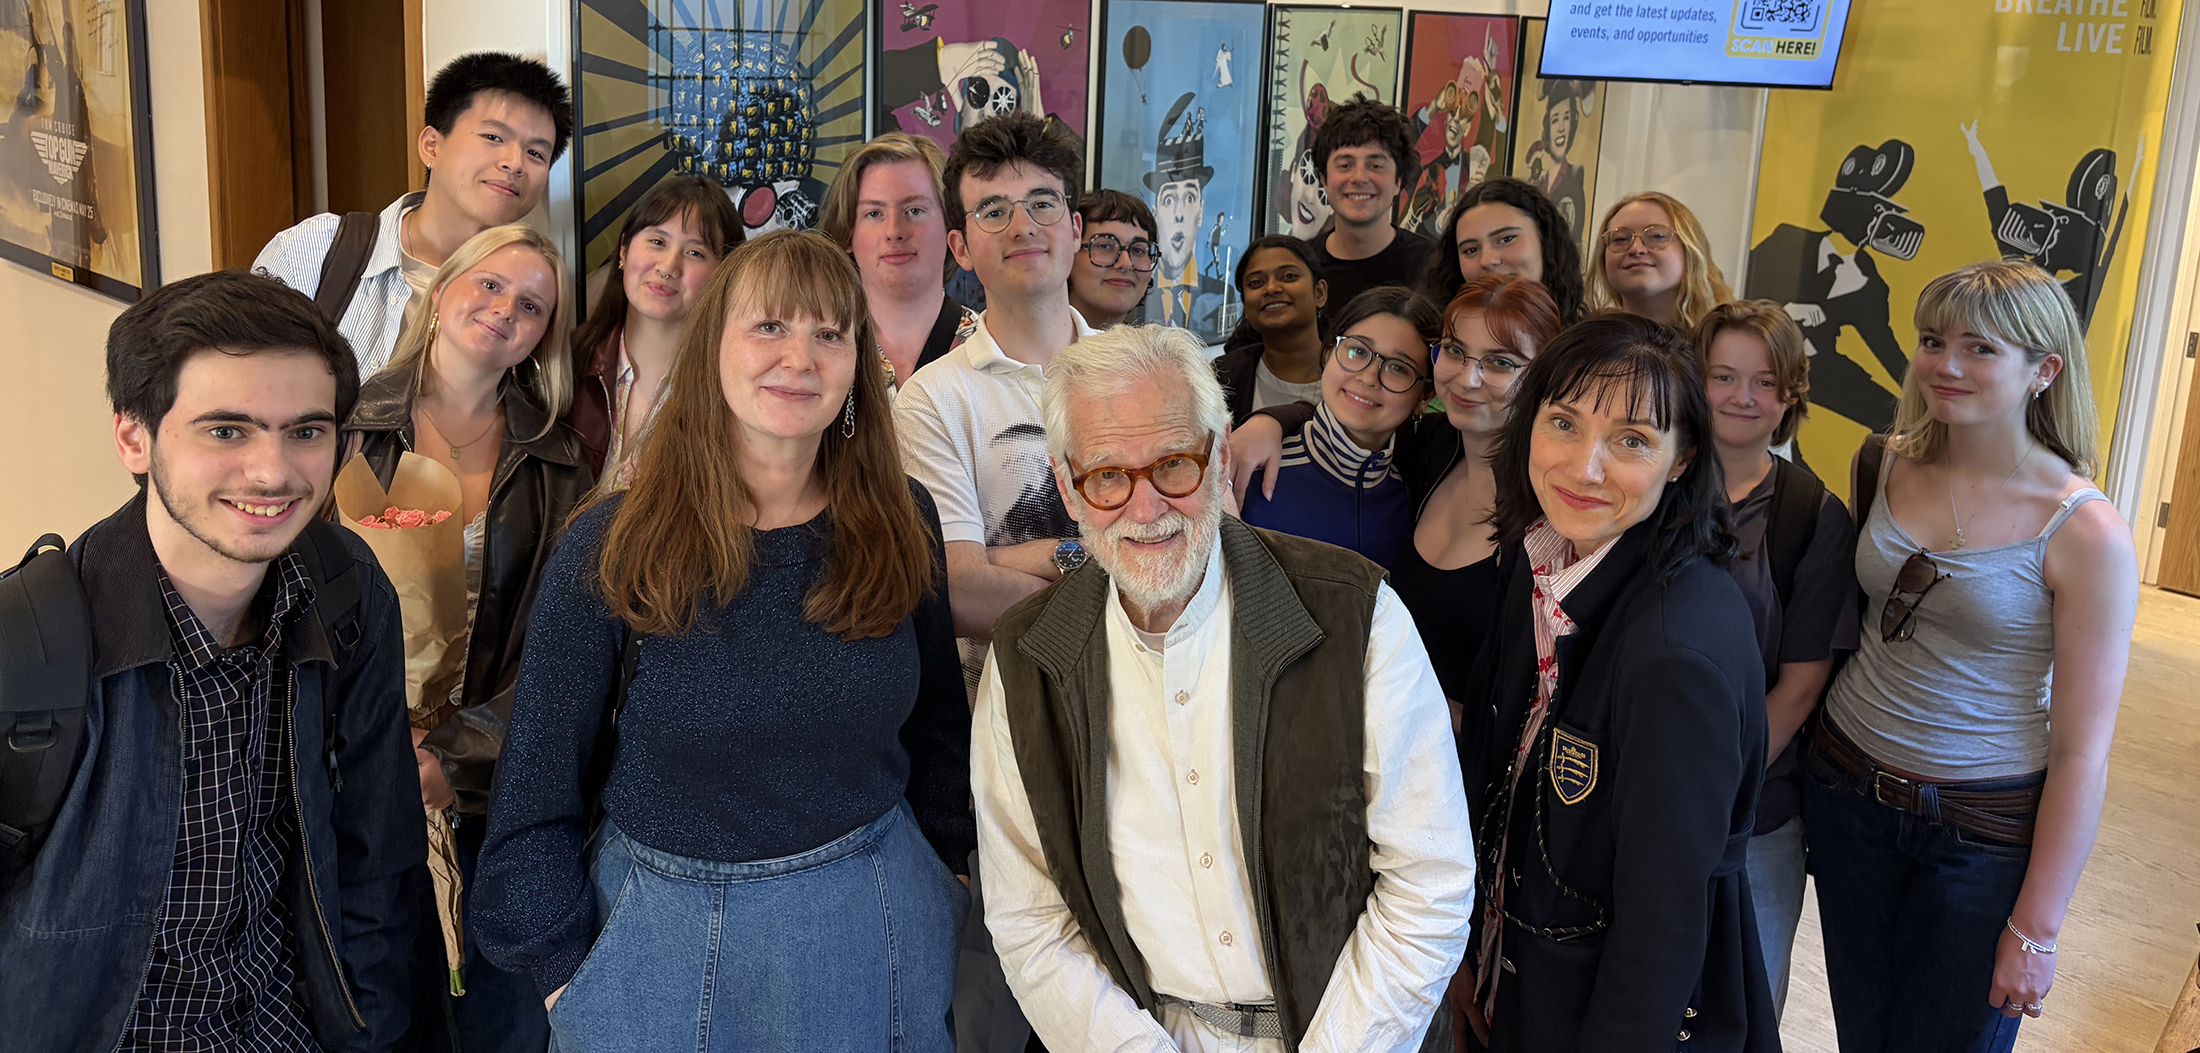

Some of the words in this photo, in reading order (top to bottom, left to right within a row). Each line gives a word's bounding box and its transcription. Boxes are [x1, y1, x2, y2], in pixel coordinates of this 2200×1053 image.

[1570, 2, 1592, 15] and
[1594, 4, 1612, 18] get
[1615, 4, 1633, 18] the
[1636, 5, 1667, 20] latest
[1670, 7, 1717, 23] updates,
[1570, 26, 1610, 41] events,
[1613, 27, 1635, 41] and
[1637, 29, 1709, 44] opportunities
[2056, 22, 2125, 54] LIVE
[1731, 38, 1774, 54] SCAN
[1775, 40, 1817, 56] HERE!
[44, 134, 59, 160] TOP
[59, 137, 76, 165] GUN
